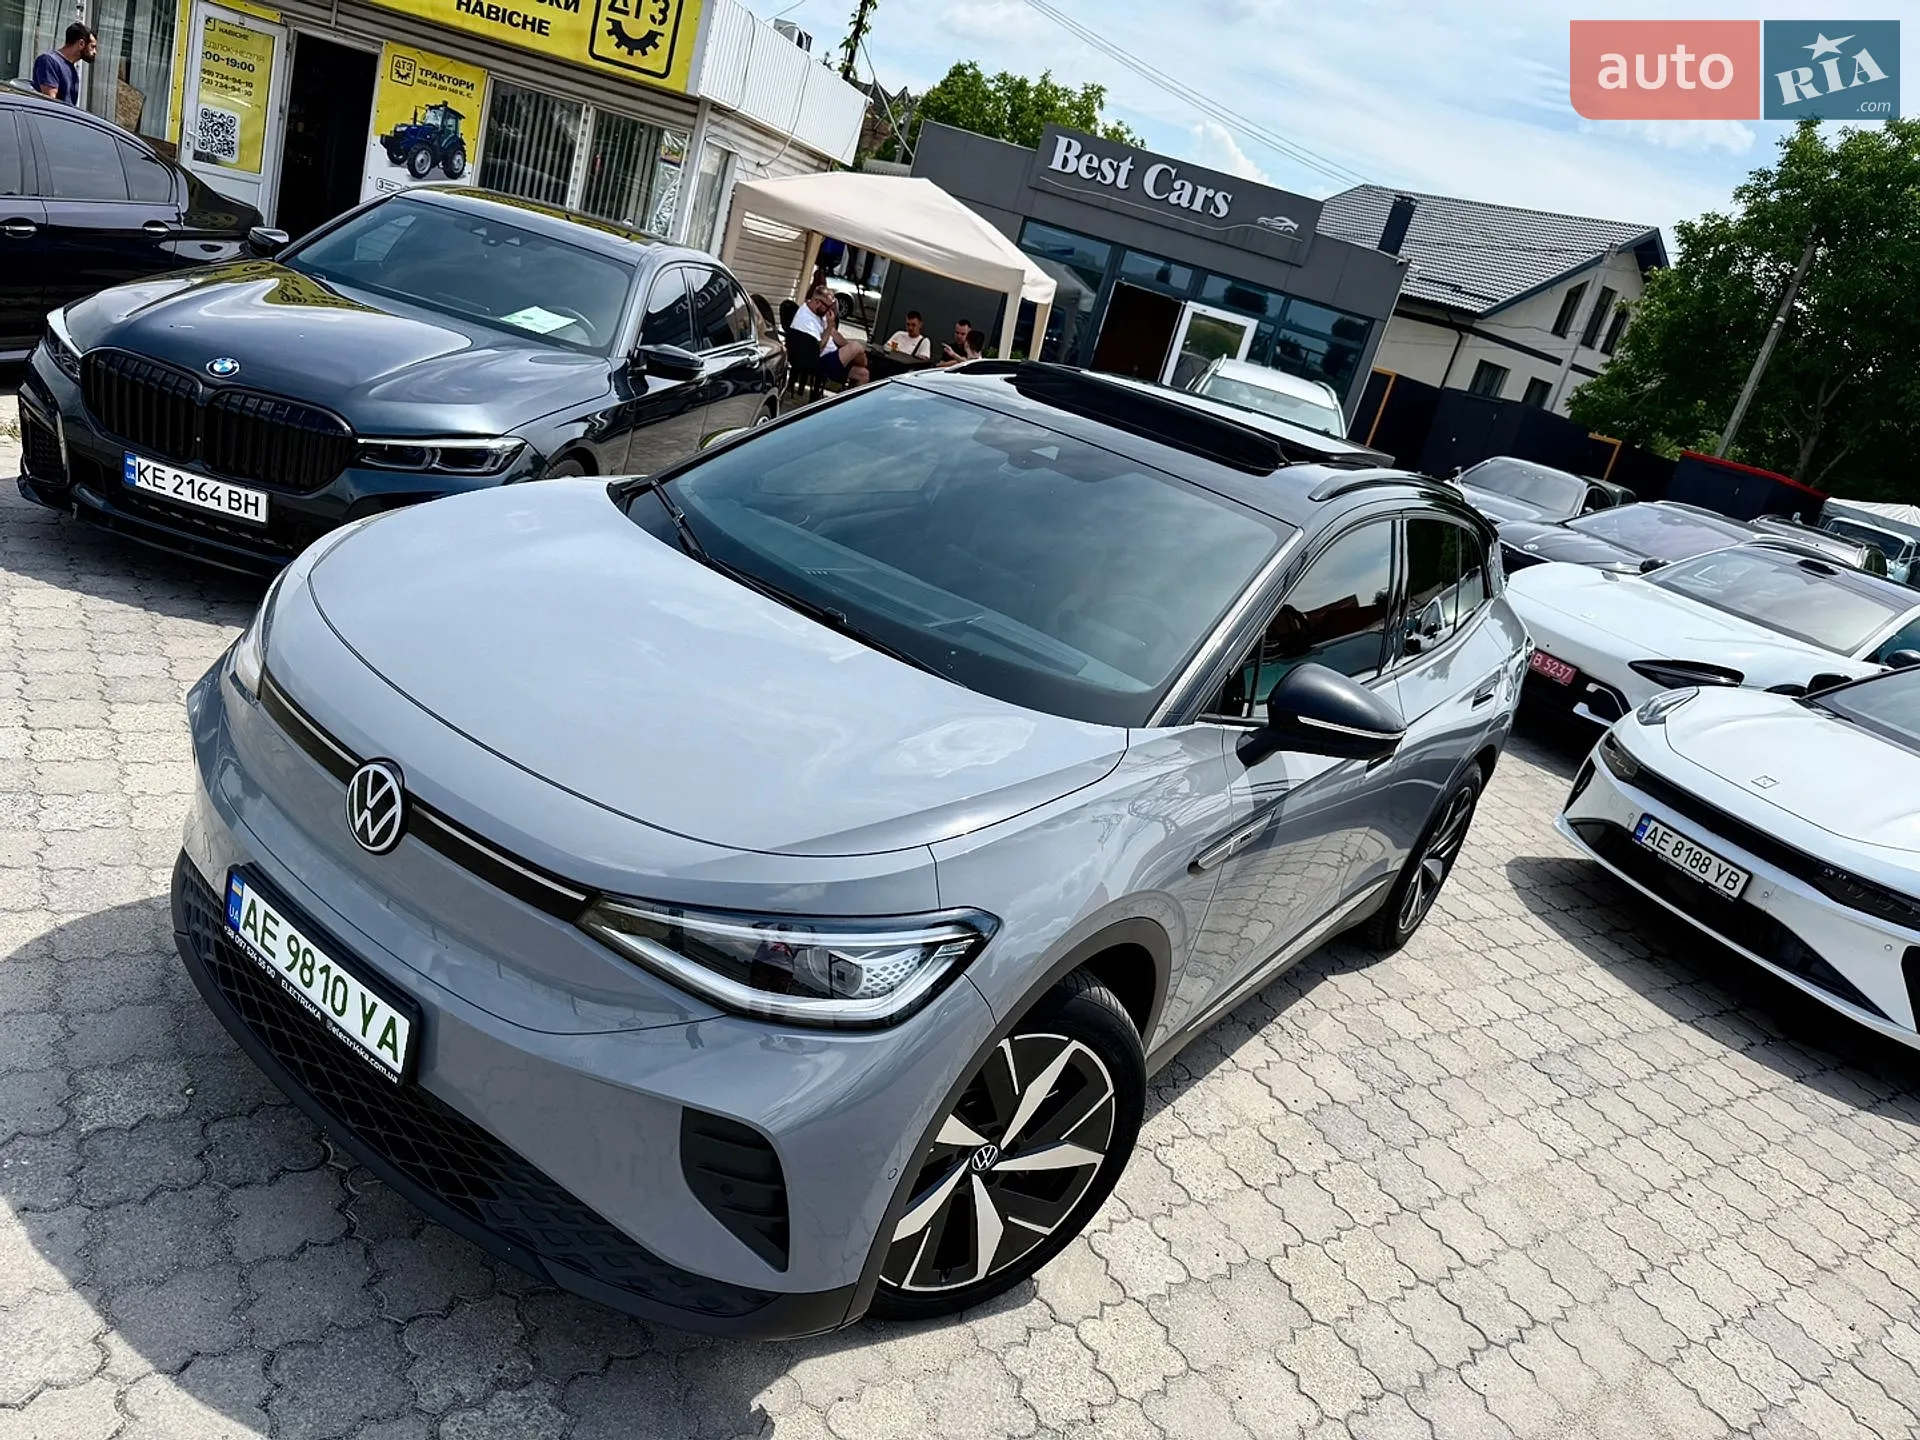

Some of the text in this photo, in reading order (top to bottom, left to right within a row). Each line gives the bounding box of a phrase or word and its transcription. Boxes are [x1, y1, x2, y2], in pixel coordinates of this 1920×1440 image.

[456, 0, 551, 37] НАВІСНЕ
[418, 68, 475, 91] ТРАКТОРИ
[1048, 134, 1232, 219] Best Cars
[137, 460, 260, 517] KE 2164 BH
[1543, 658, 1572, 680] 5237
[1645, 826, 1673, 852] AE
[1671, 840, 1712, 874] 8188
[1714, 862, 1740, 891] YB
[229, 904, 239, 922] UA
[242, 898, 399, 1064] AE 9810 YA
